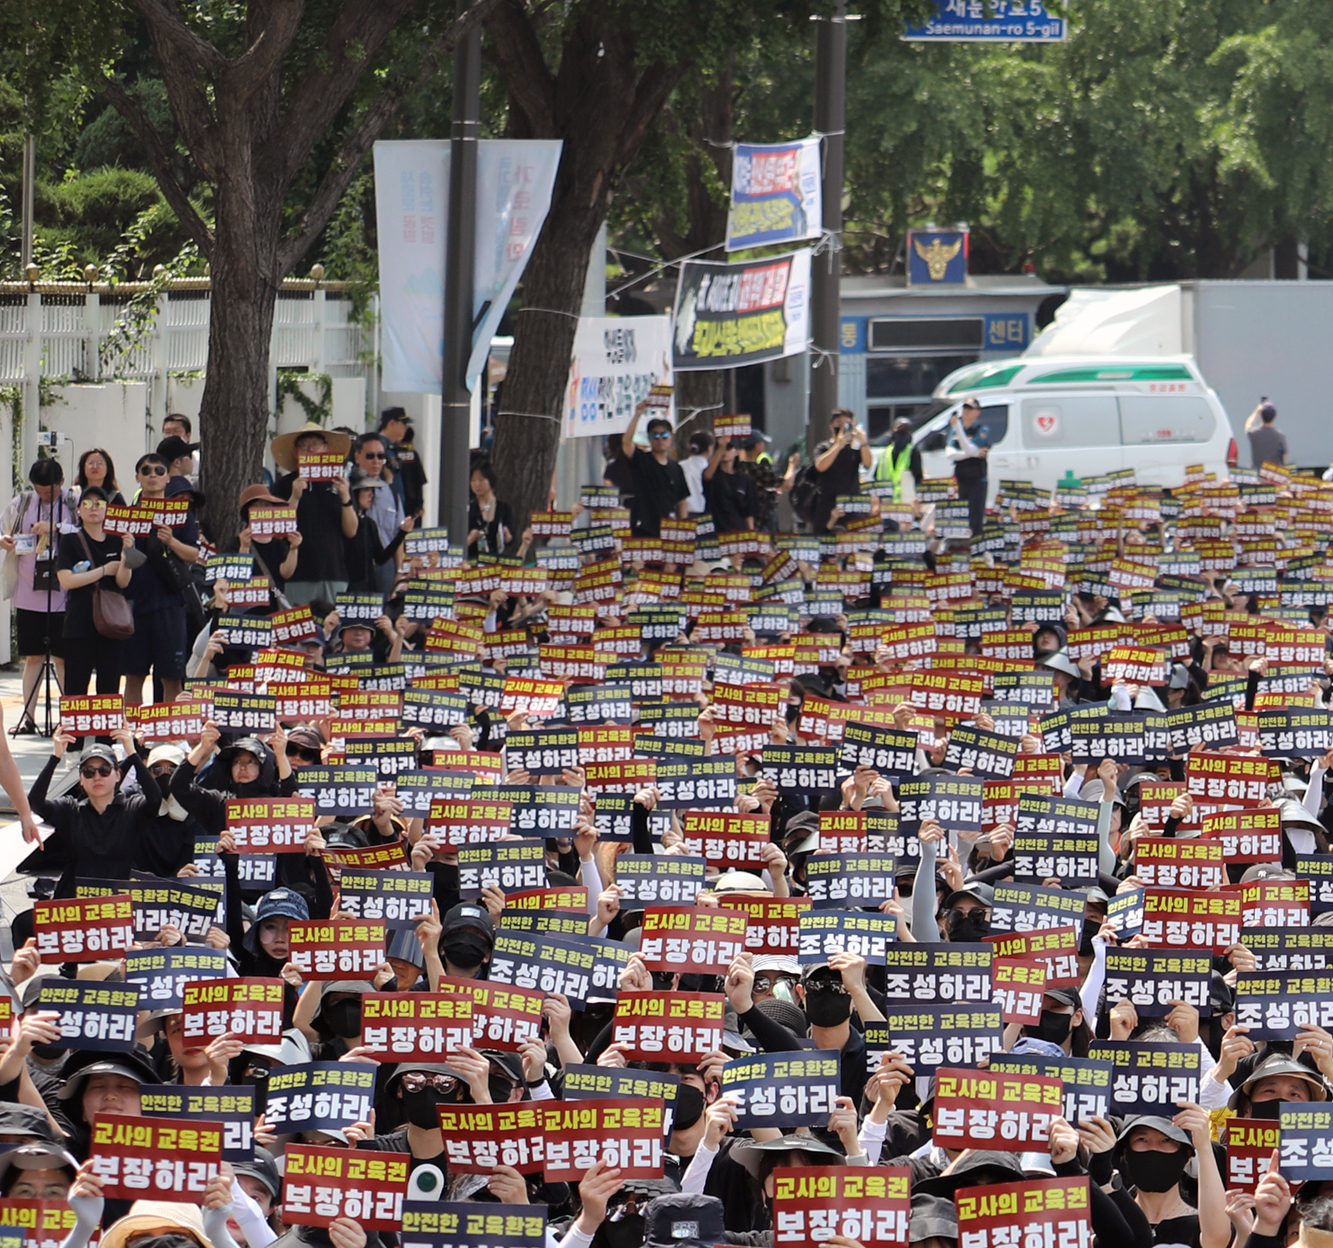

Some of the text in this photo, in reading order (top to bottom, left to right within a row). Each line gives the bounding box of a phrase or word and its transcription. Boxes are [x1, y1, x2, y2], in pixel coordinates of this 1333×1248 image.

[926, 22, 1059, 37] Saemunan-ro 5-gil
[989, 321, 1023, 344] 센터
[299, 466, 344, 479] 보장하라
[251, 521, 297, 534] 보장하라
[61, 699, 122, 711] 교사의 교육권
[1189, 758, 1267, 775] 교사의 교육권
[1187, 777, 1267, 801] 보장하라
[807, 859, 893, 874] 안전한 교육환경
[809, 878, 894, 900] 조성하라
[36, 902, 131, 924] 교사의 교육권
[1145, 896, 1240, 915] 교사의 교육권
[35, 926, 135, 956] 보장하라
[1142, 920, 1240, 947] 보장하라
[1237, 980, 1281, 995] 안전한
[268, 1071, 373, 1091] 안전한 교육환경
[265, 1092, 371, 1124] 조성하라
[958, 1186, 1087, 1220] 교사의 교육권
